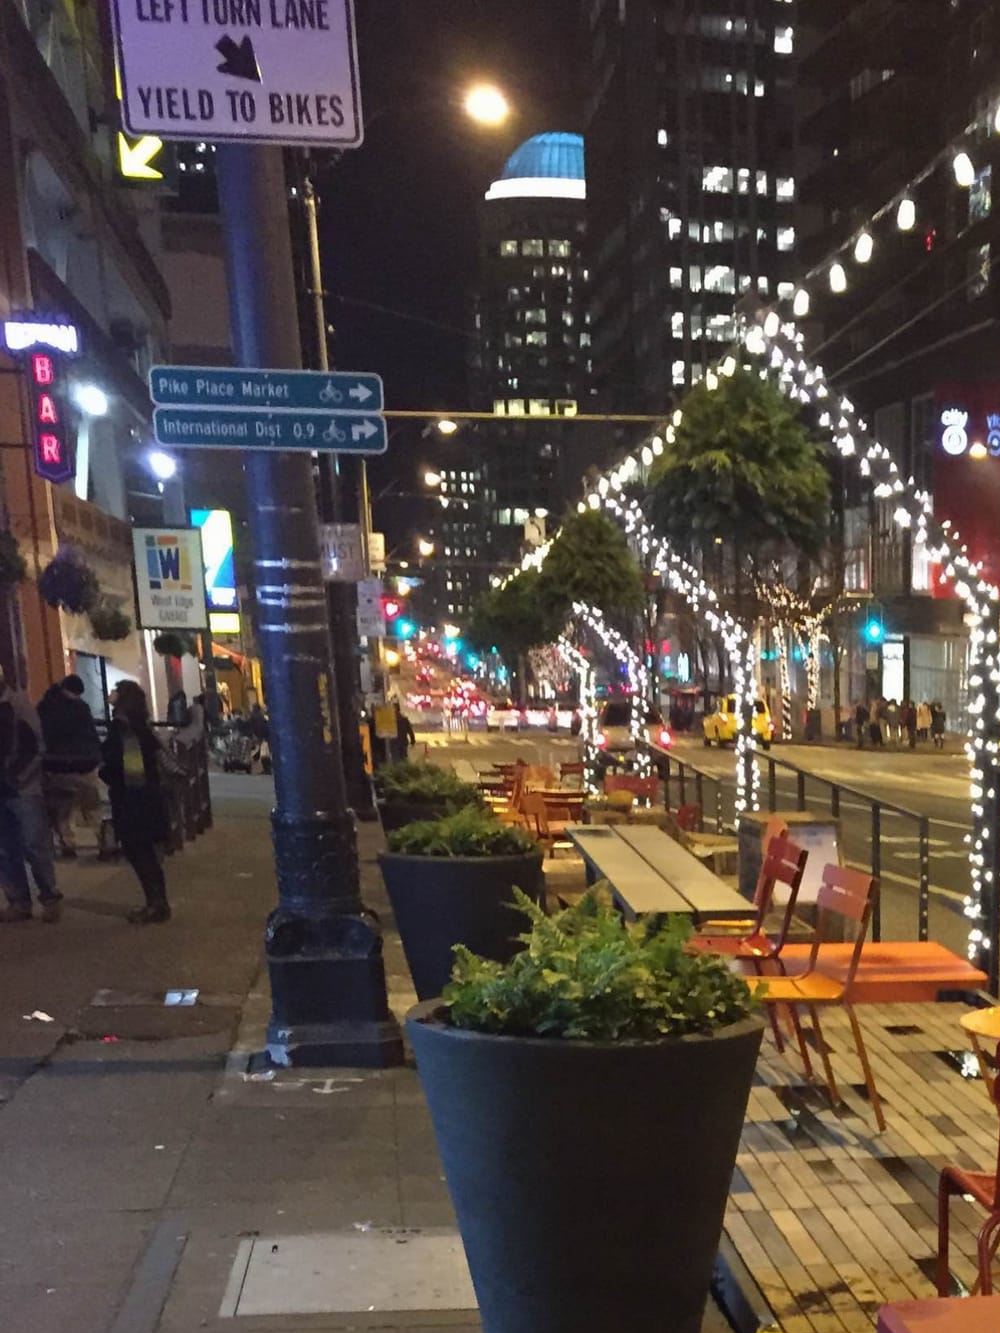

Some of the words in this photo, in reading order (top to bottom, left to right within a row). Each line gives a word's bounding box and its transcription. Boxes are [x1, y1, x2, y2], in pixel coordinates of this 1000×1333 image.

[136, 0, 189, 22] LEFT
[201, 0, 262, 27] TURN
[270, 0, 330, 30] LANE
[137, 87, 215, 122] YIELD
[225, 89, 257, 124] TO
[269, 92, 345, 129] BIKES
[159, 378, 189, 396] Pike
[196, 379, 234, 398] Place
[242, 381, 290, 399] Market
[32, 354, 61, 464] BAR
[163, 419, 248, 438] International
[255, 421, 282, 438] Dist
[293, 422, 315, 439] 0.9
